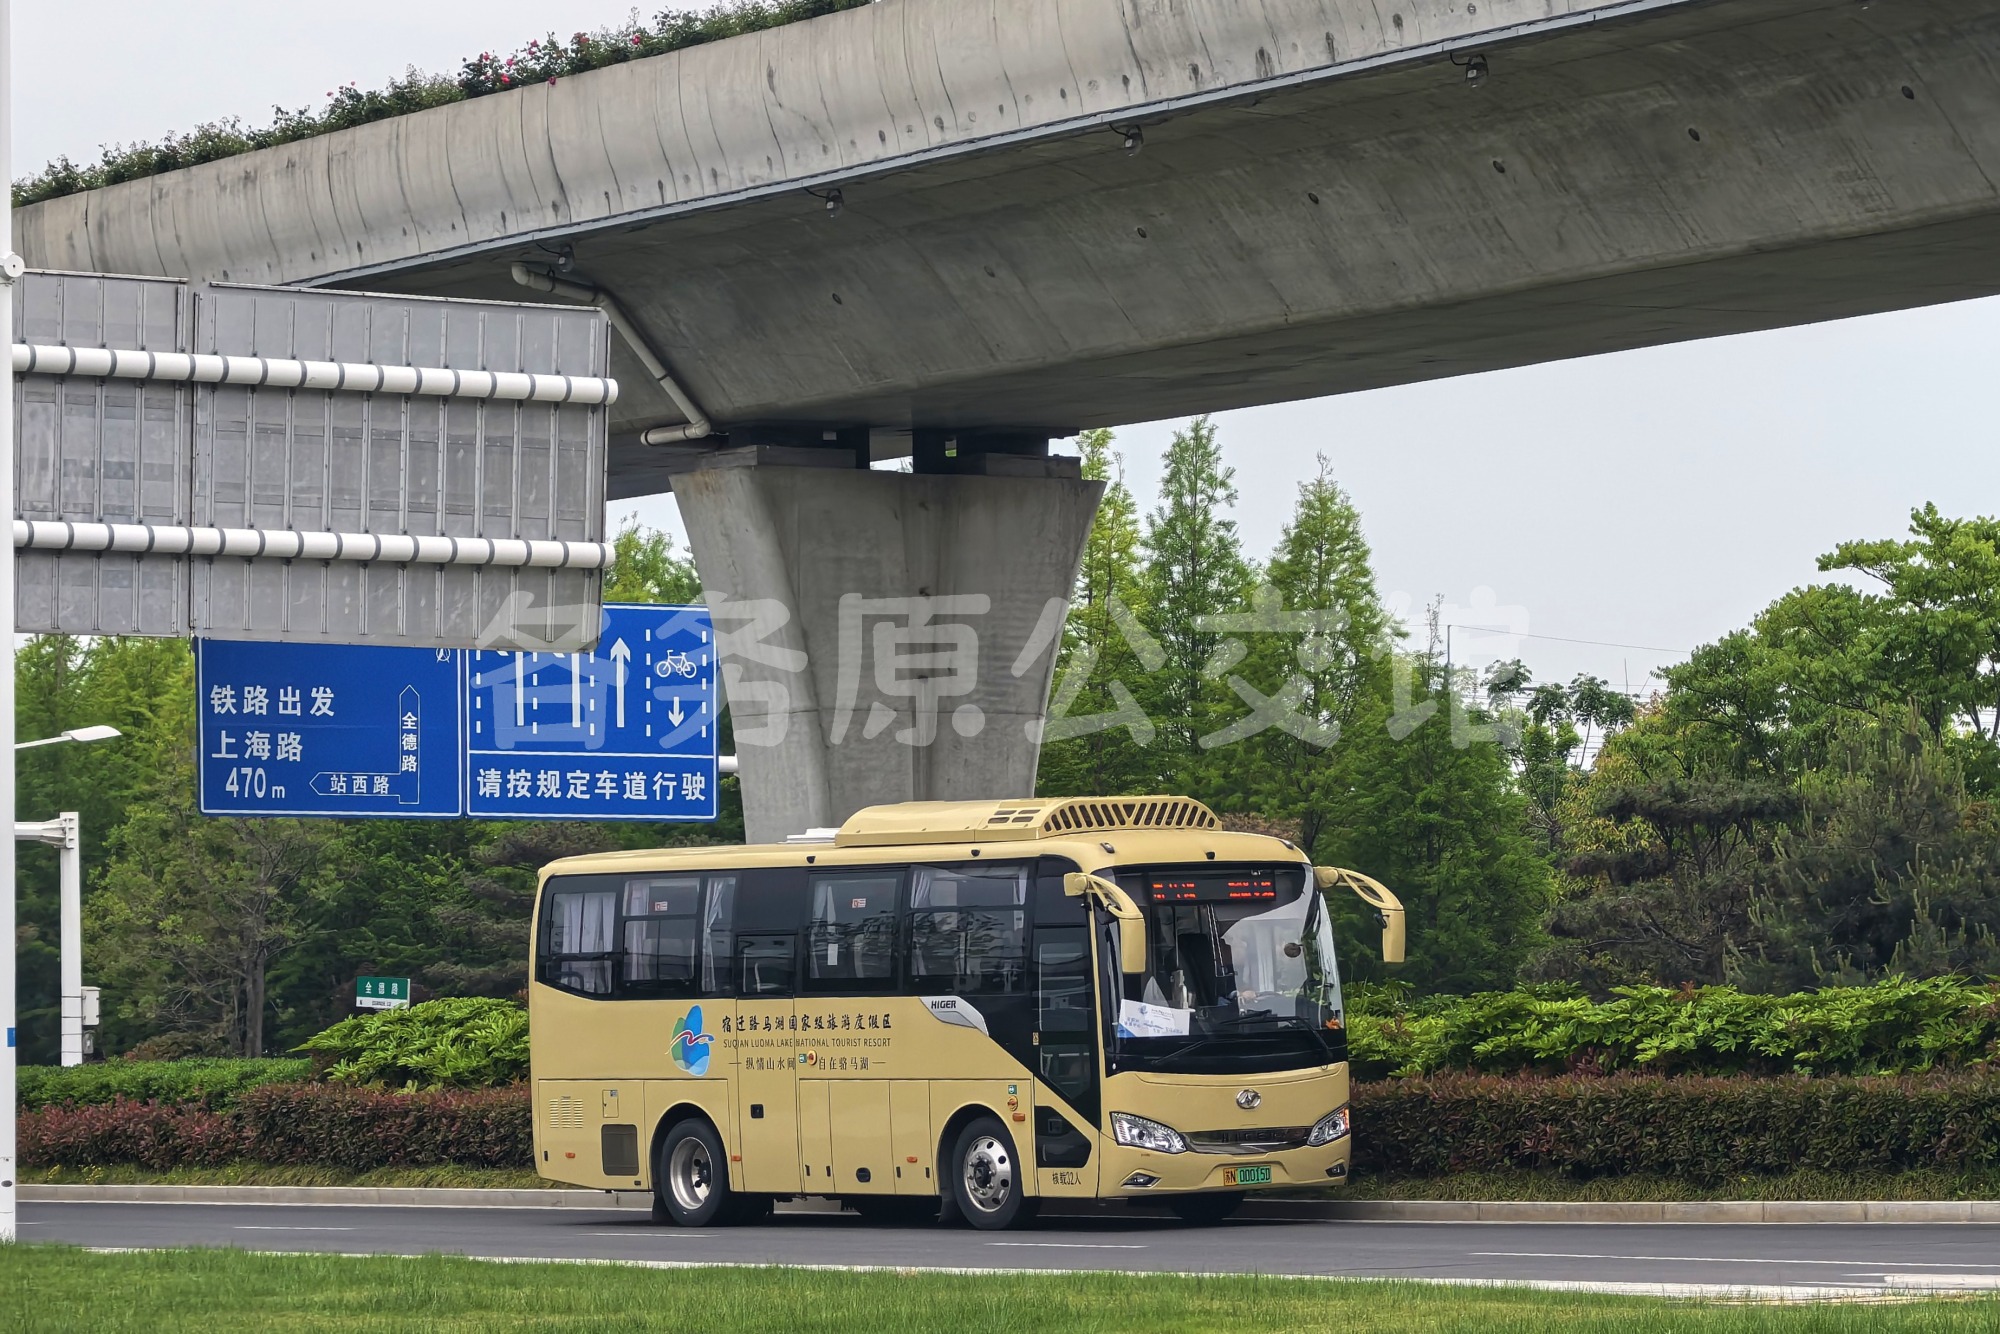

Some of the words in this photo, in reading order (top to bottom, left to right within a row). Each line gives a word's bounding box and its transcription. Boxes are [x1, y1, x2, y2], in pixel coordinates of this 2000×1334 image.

[210, 684, 335, 717] 铁路出发
[211, 730, 304, 762] 上海路
[401, 711, 418, 773] 全德路
[330, 774, 390, 795] 站西路
[476, 767, 707, 801] 请按规定车道行驶
[930, 1000, 957, 1010] HIGER
[722, 1012, 892, 1033] 宿迁骆马湖国家级旅游度假区
[723, 1038, 749, 1049] SUQIAN
[751, 1038, 775, 1048] LUOMA
[776, 1038, 793, 1048] LAKE
[795, 1038, 830, 1048] NATIONAL
[831, 1037, 861, 1048] TOURIST
[863, 1037, 891, 1048] RESORT
[1052, 1171, 1082, 1186] 核载32人
